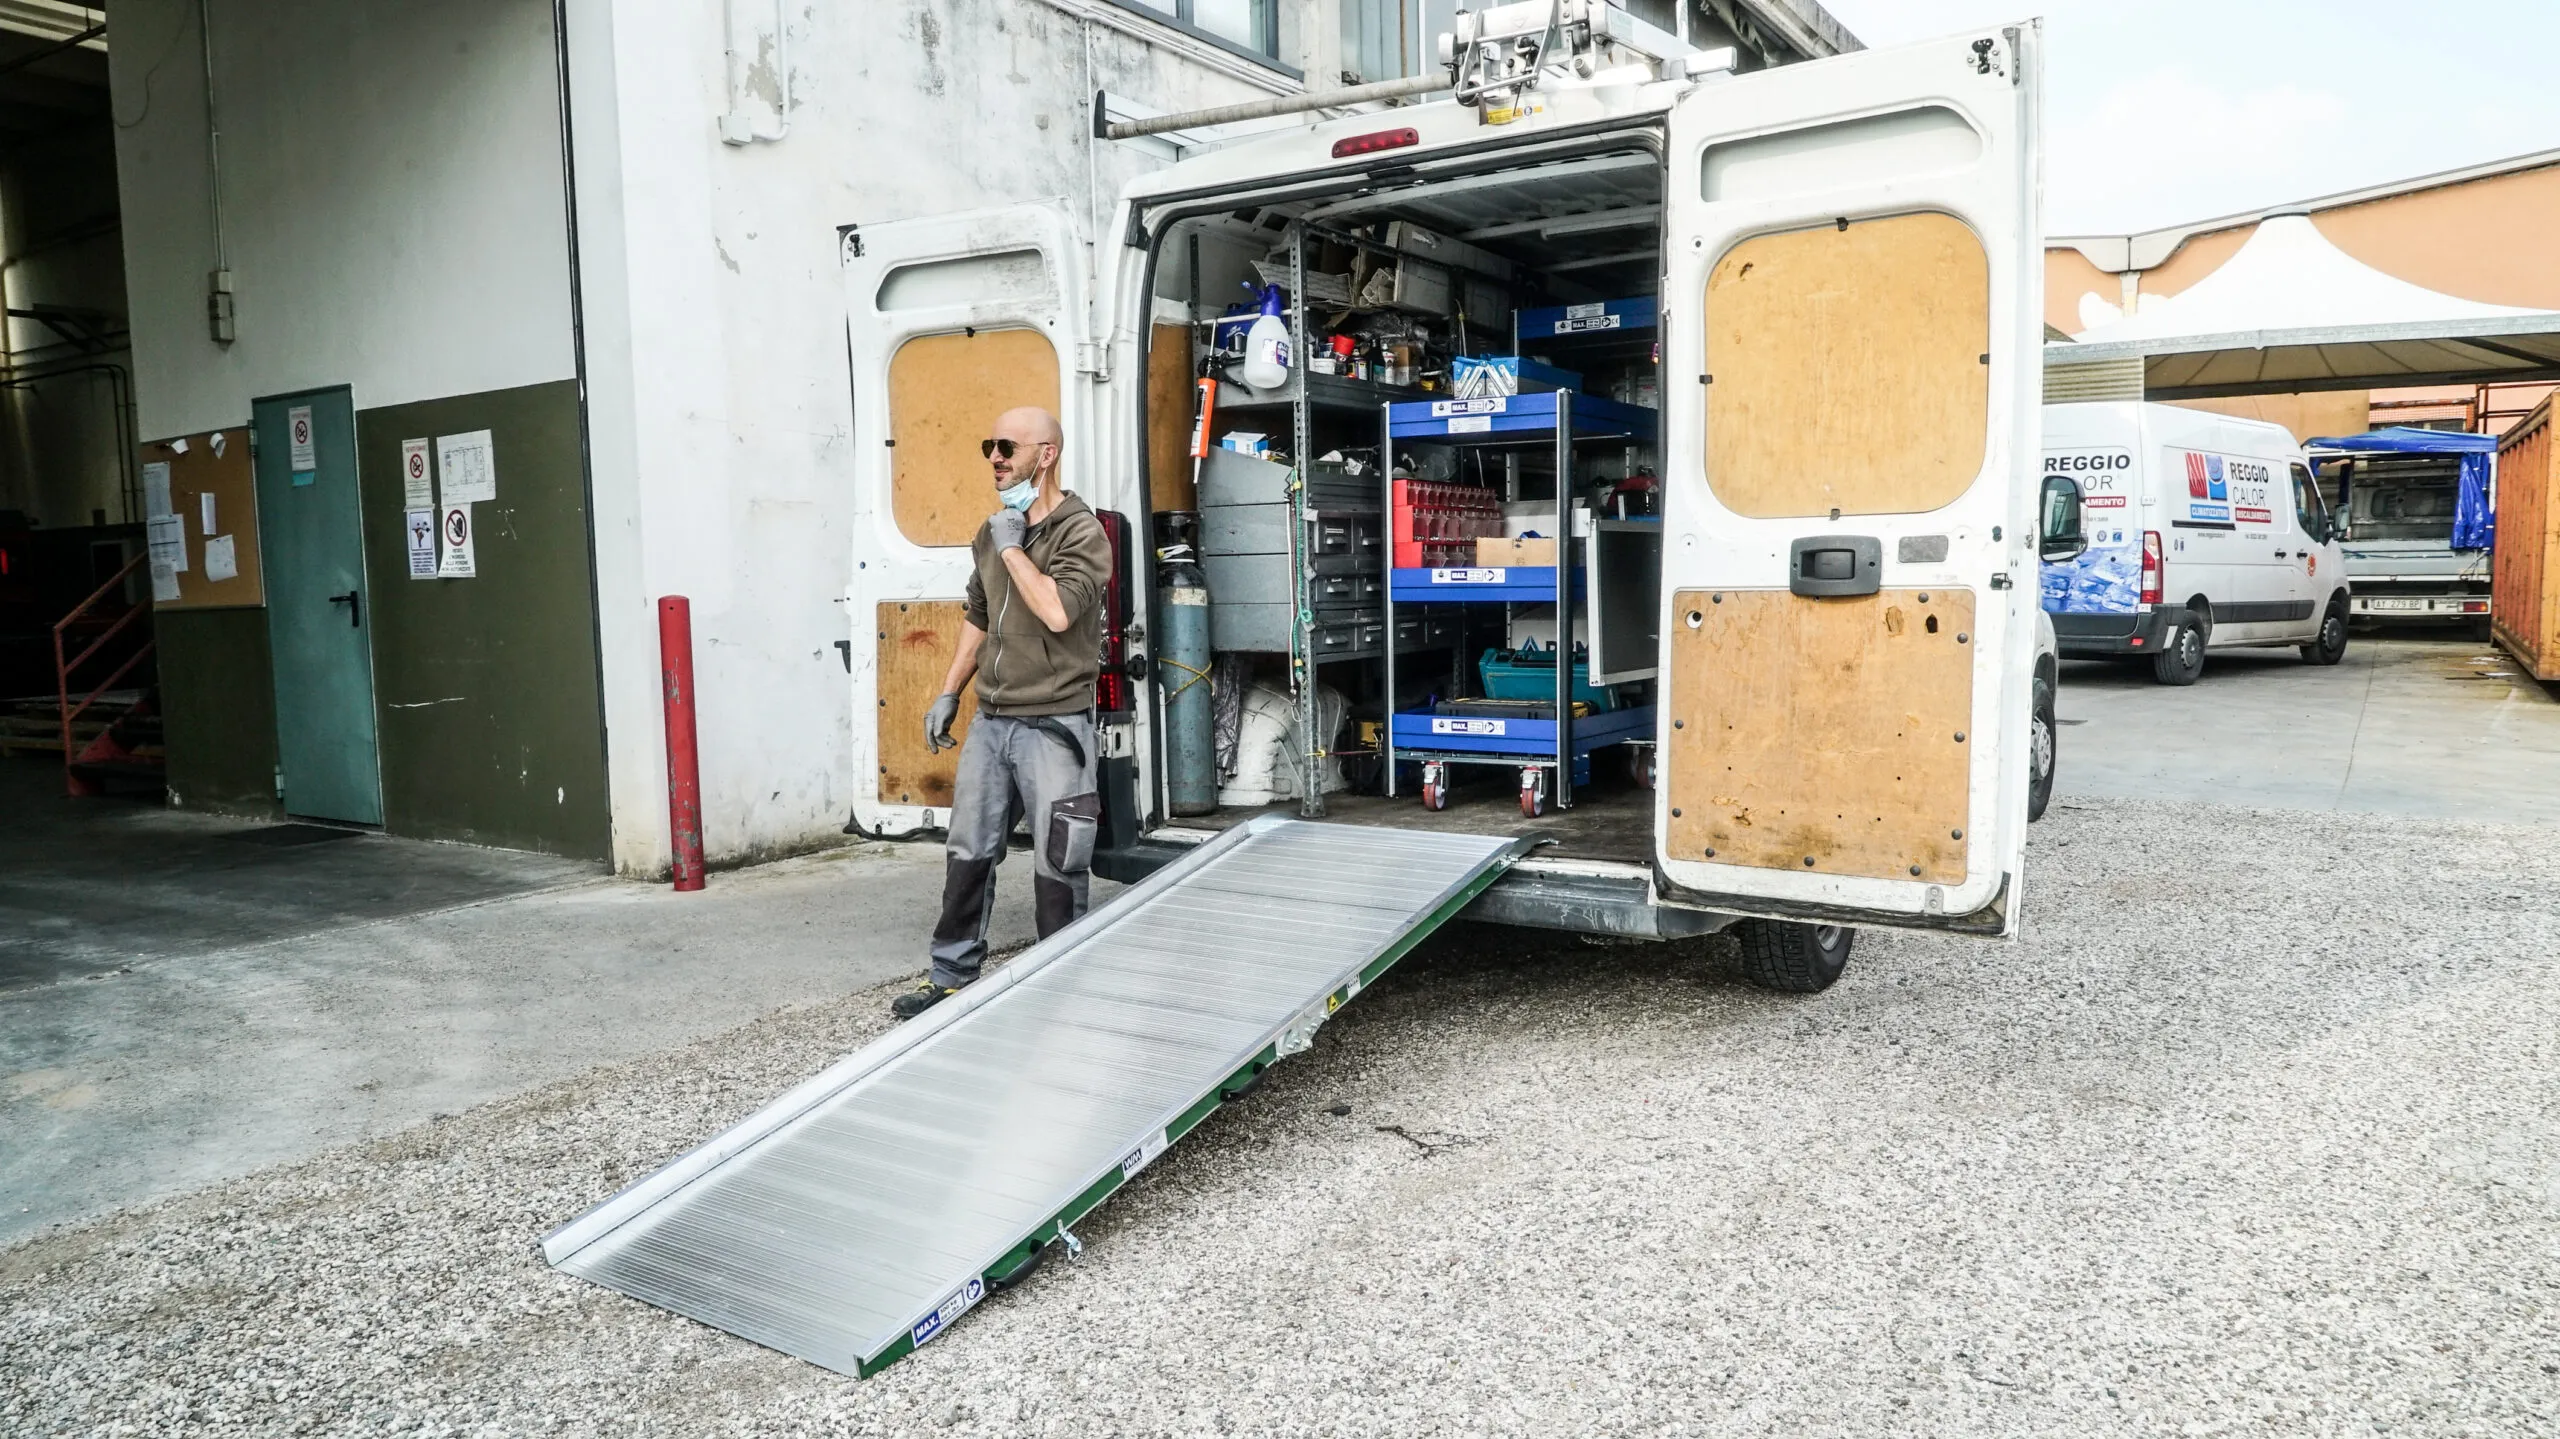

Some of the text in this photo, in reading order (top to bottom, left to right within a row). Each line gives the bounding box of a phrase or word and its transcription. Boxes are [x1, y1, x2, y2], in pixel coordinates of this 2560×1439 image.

[2044, 454, 2131, 472] REGGIO
[2229, 462, 2269, 483] REGGIO
[2232, 486, 2266, 507] CALOR
[916, 1316, 939, 1338] MAX.
